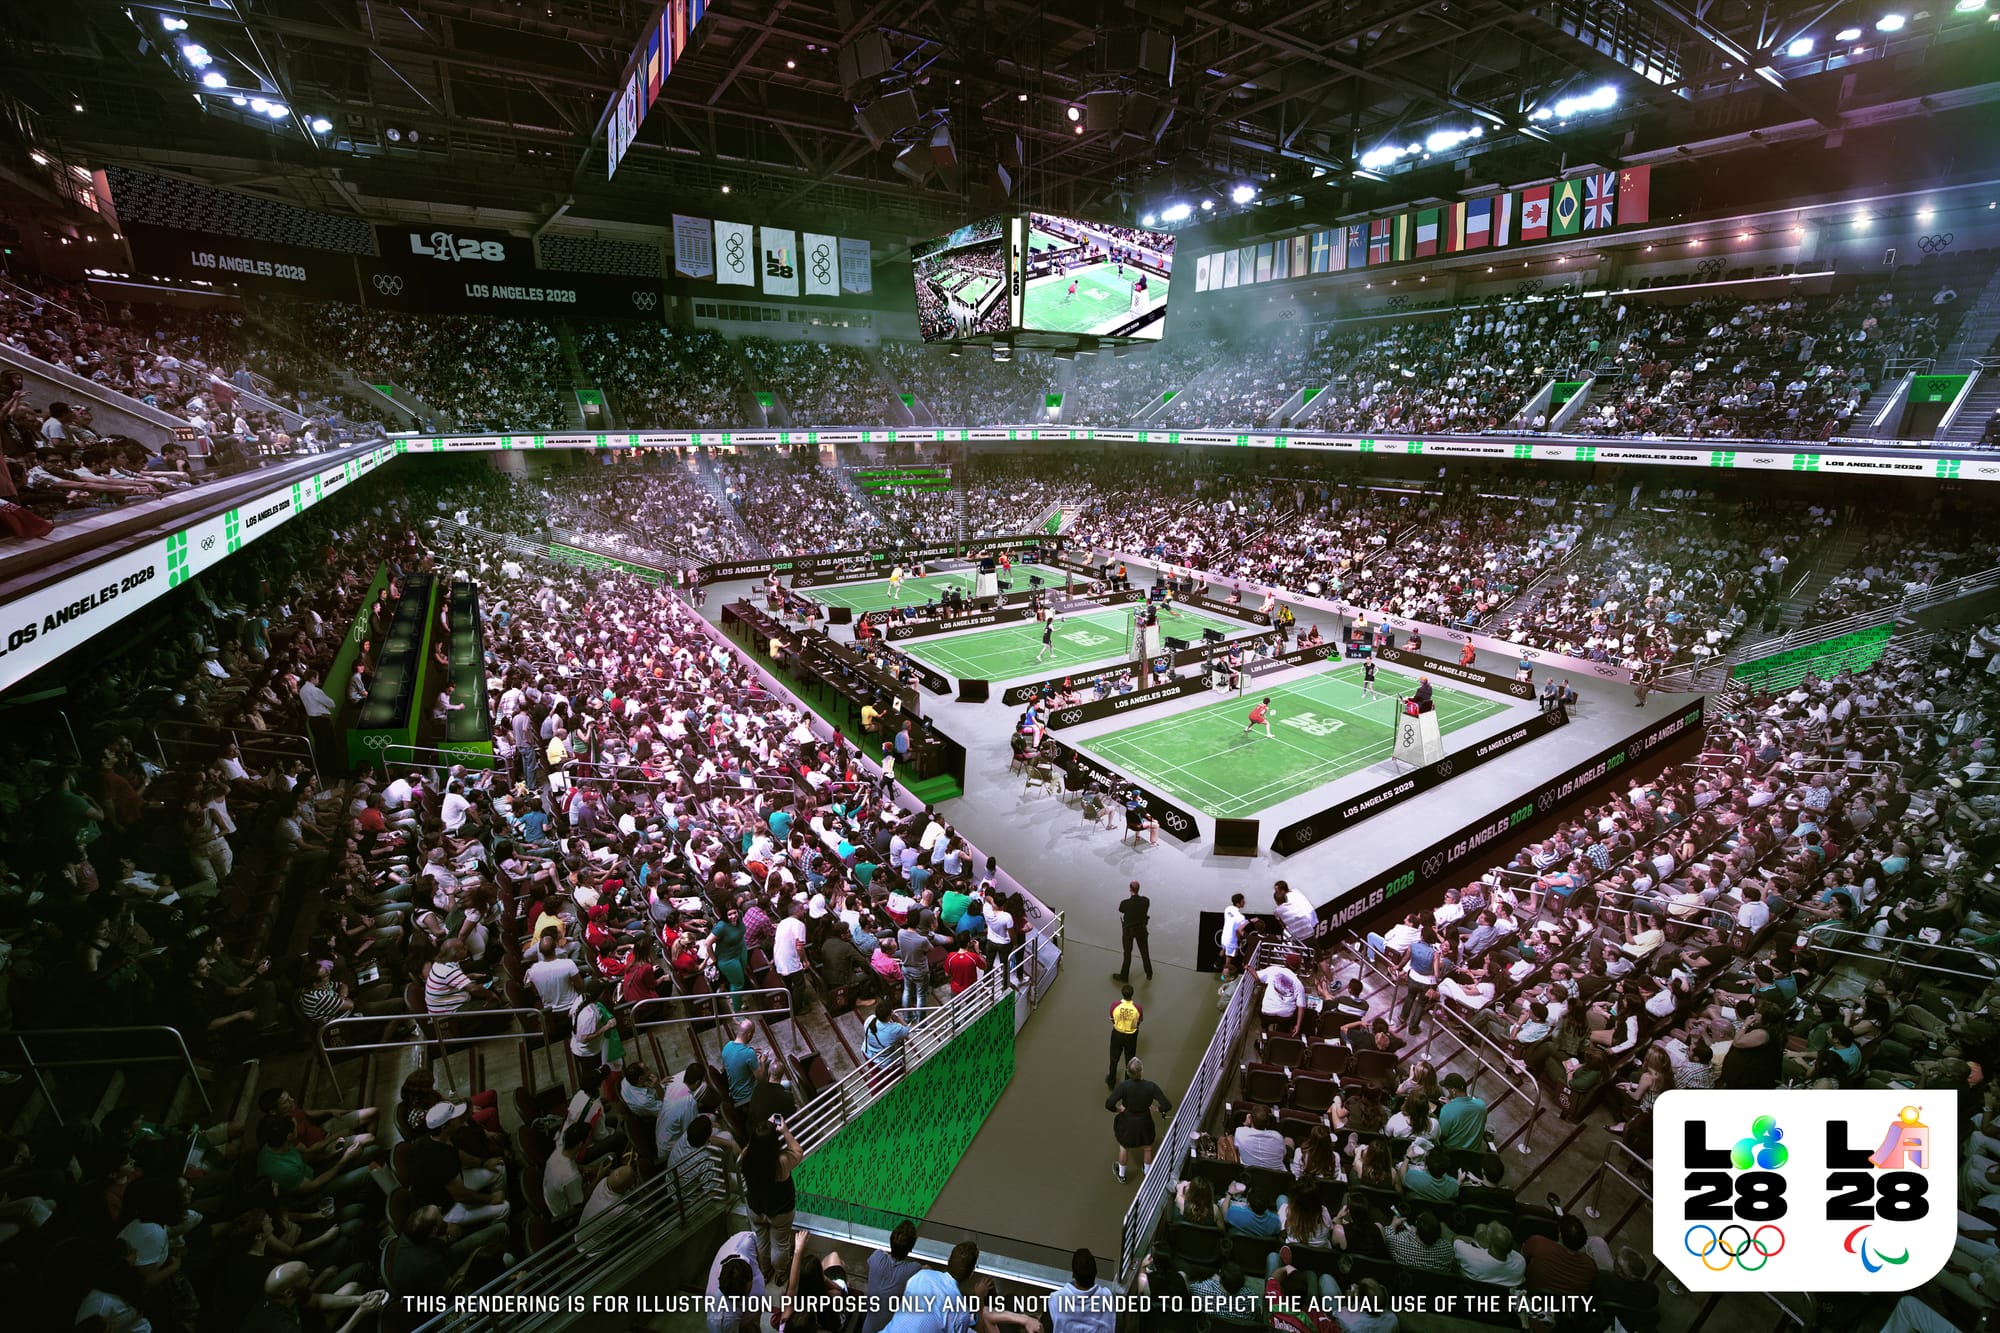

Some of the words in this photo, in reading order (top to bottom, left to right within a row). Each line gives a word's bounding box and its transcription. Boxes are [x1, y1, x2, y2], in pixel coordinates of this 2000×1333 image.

[410, 231, 505, 262] LA28
[191, 251, 216, 269] LOS
[219, 254, 272, 277] ANGELES
[275, 262, 306, 281] 2028
[766, 263, 794, 279] 28
[465, 283, 489, 298] LOS
[492, 285, 544, 301] ANGELES
[547, 289, 576, 303] 2028
[997, 540, 1024, 548] ANGELES
[717, 568, 734, 576] LOS
[734, 564, 771, 574] ANGELES
[816, 558, 832, 566] LOS
[42, 583, 118, 636] ANGELES
[121, 565, 155, 594] 2028
[952, 618, 979, 628] ANGELES
[1074, 677, 1086, 686] LOS
[1424, 661, 1438, 670] LOS
[1438, 665, 1468, 678] ANGELES
[1468, 673, 1486, 682] 2028
[1114, 700, 1129, 709] LOS
[1130, 692, 1161, 705] ANGELES
[1162, 686, 1180, 697] 2028
[1644, 732, 1657, 750] LOS
[1658, 718, 1684, 742] ANGELES
[1684, 708, 1700, 726] 2028
[1476, 746, 1488, 757] LOS
[1488, 736, 1512, 751] ANGELES
[1512, 728, 1527, 742] 2028
[1557, 780, 1573, 800] LOS
[1573, 762, 1606, 790] ANGELES
[1606, 751, 1626, 772] 2028
[1343, 802, 1359, 818] LOS
[1360, 790, 1394, 812] ANGELES
[1393, 780, 1415, 796] 2028
[1447, 840, 1467, 863] LOS
[1468, 816, 1510, 852] ANGELES
[1510, 803, 1534, 827] 2028
[1330, 888, 1384, 930] ANGELES
[1385, 870, 1416, 899] 2028
